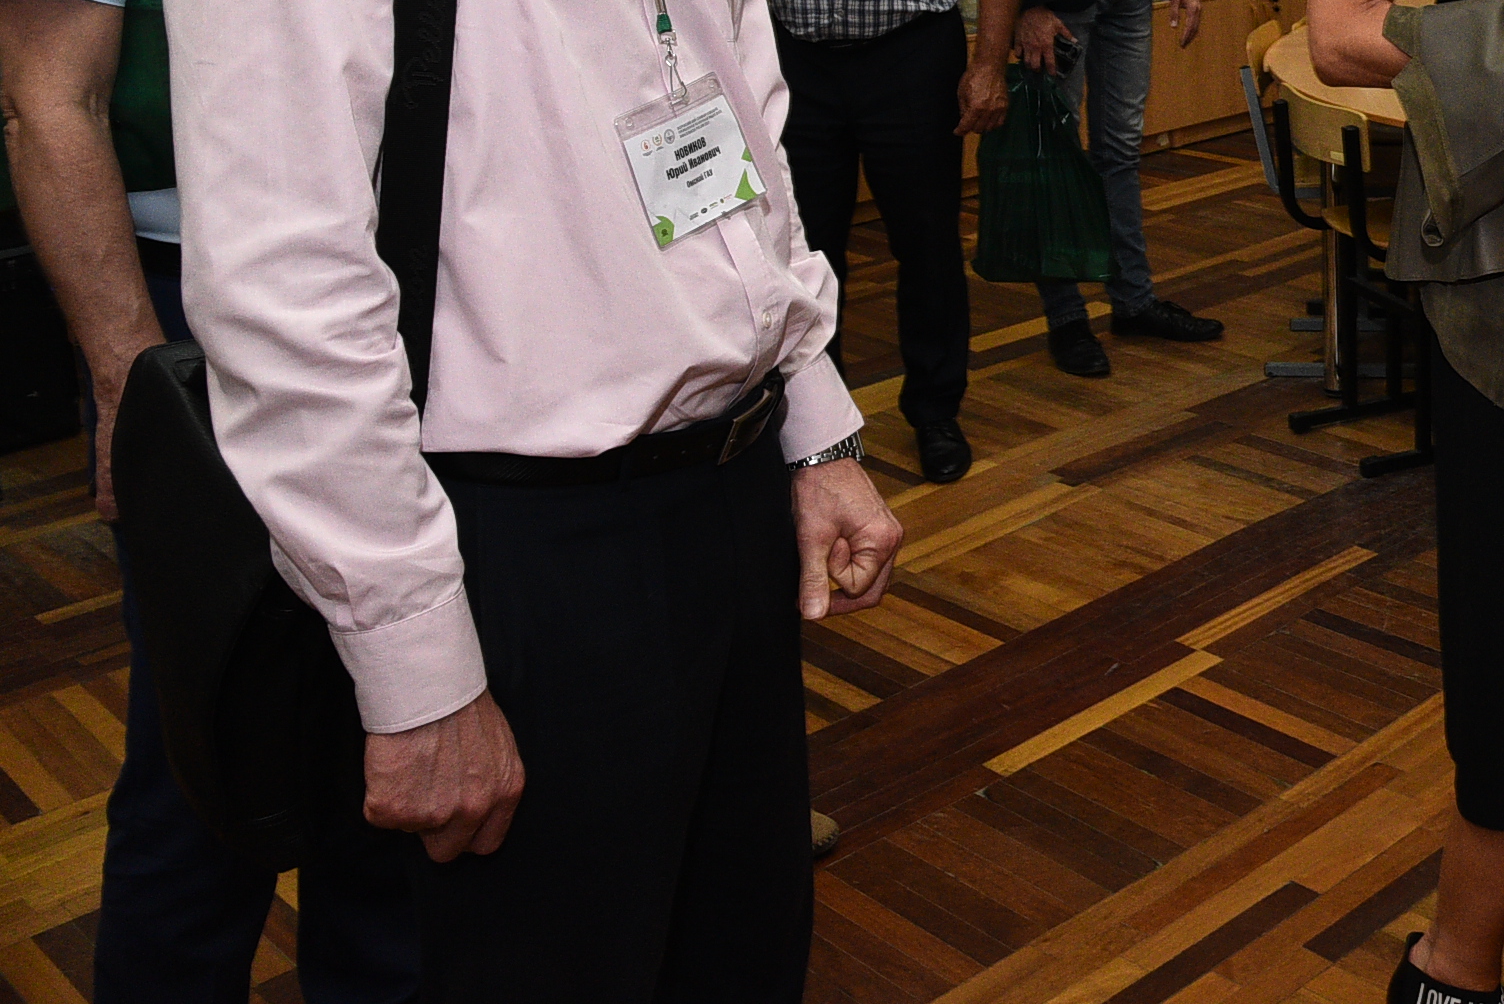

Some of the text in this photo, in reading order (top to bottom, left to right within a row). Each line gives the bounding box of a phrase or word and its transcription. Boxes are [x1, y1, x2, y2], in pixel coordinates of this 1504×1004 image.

[666, 146, 721, 180] Юрий Иванович
[674, 137, 707, 161] НОВИКОВ
